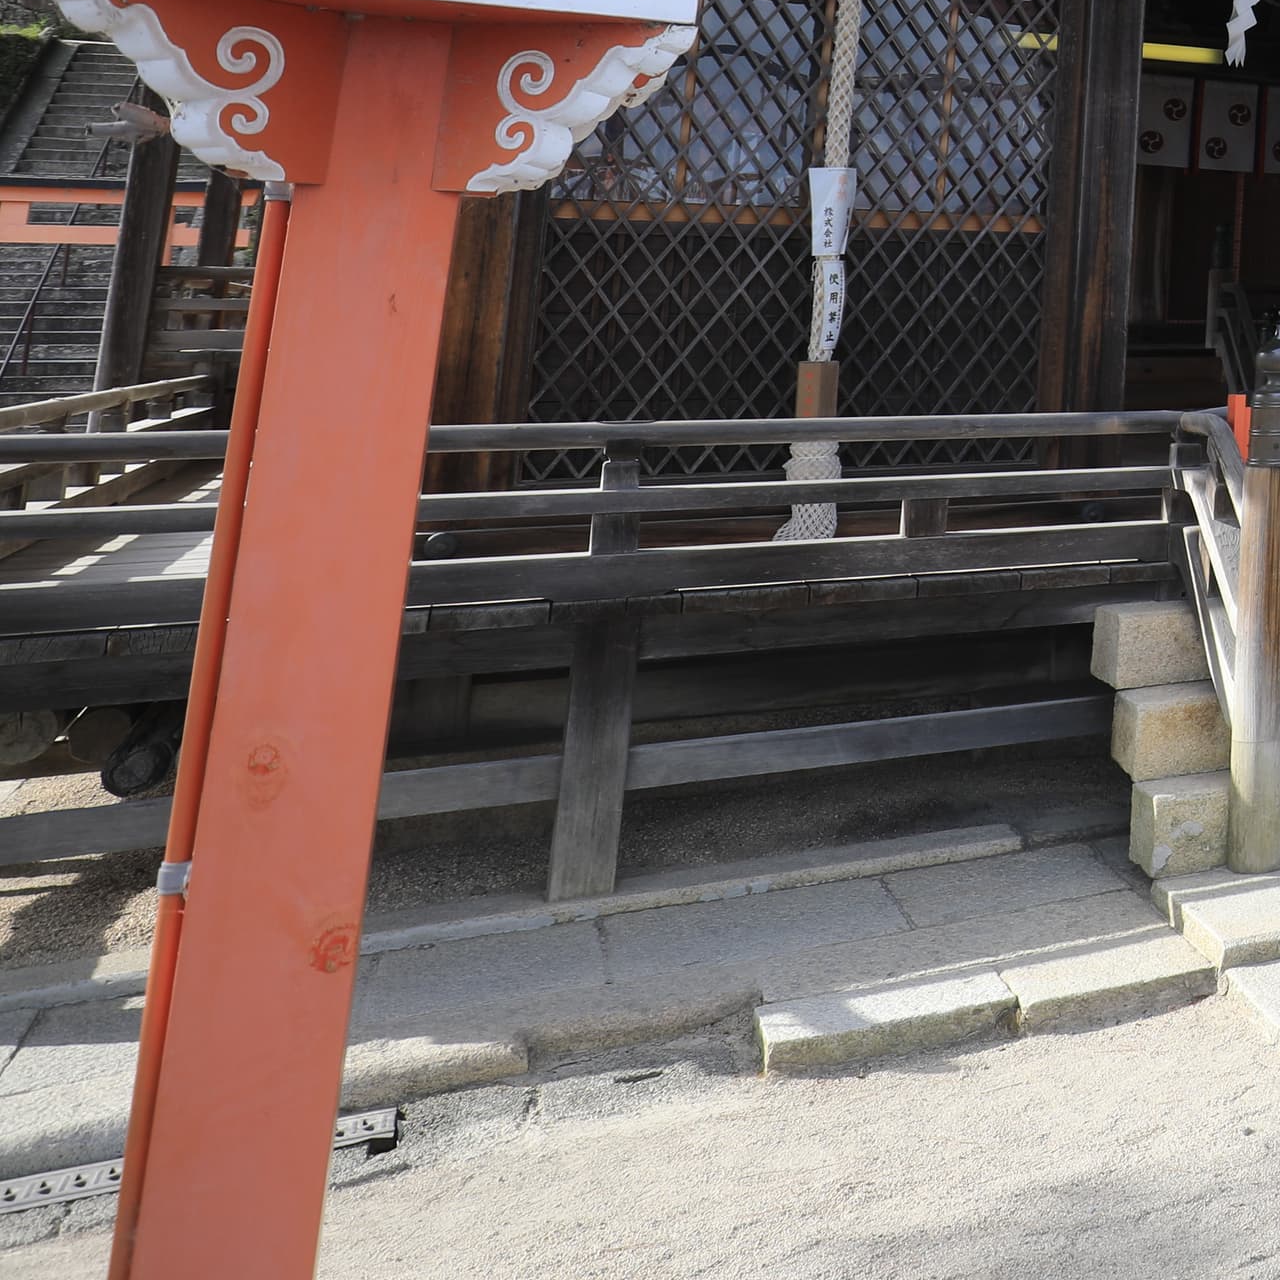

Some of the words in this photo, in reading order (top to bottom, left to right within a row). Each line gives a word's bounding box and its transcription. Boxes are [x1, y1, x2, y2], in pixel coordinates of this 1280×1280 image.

[823, 206, 833, 248] 株式会社
[825, 273, 840, 342] 使用禁止
